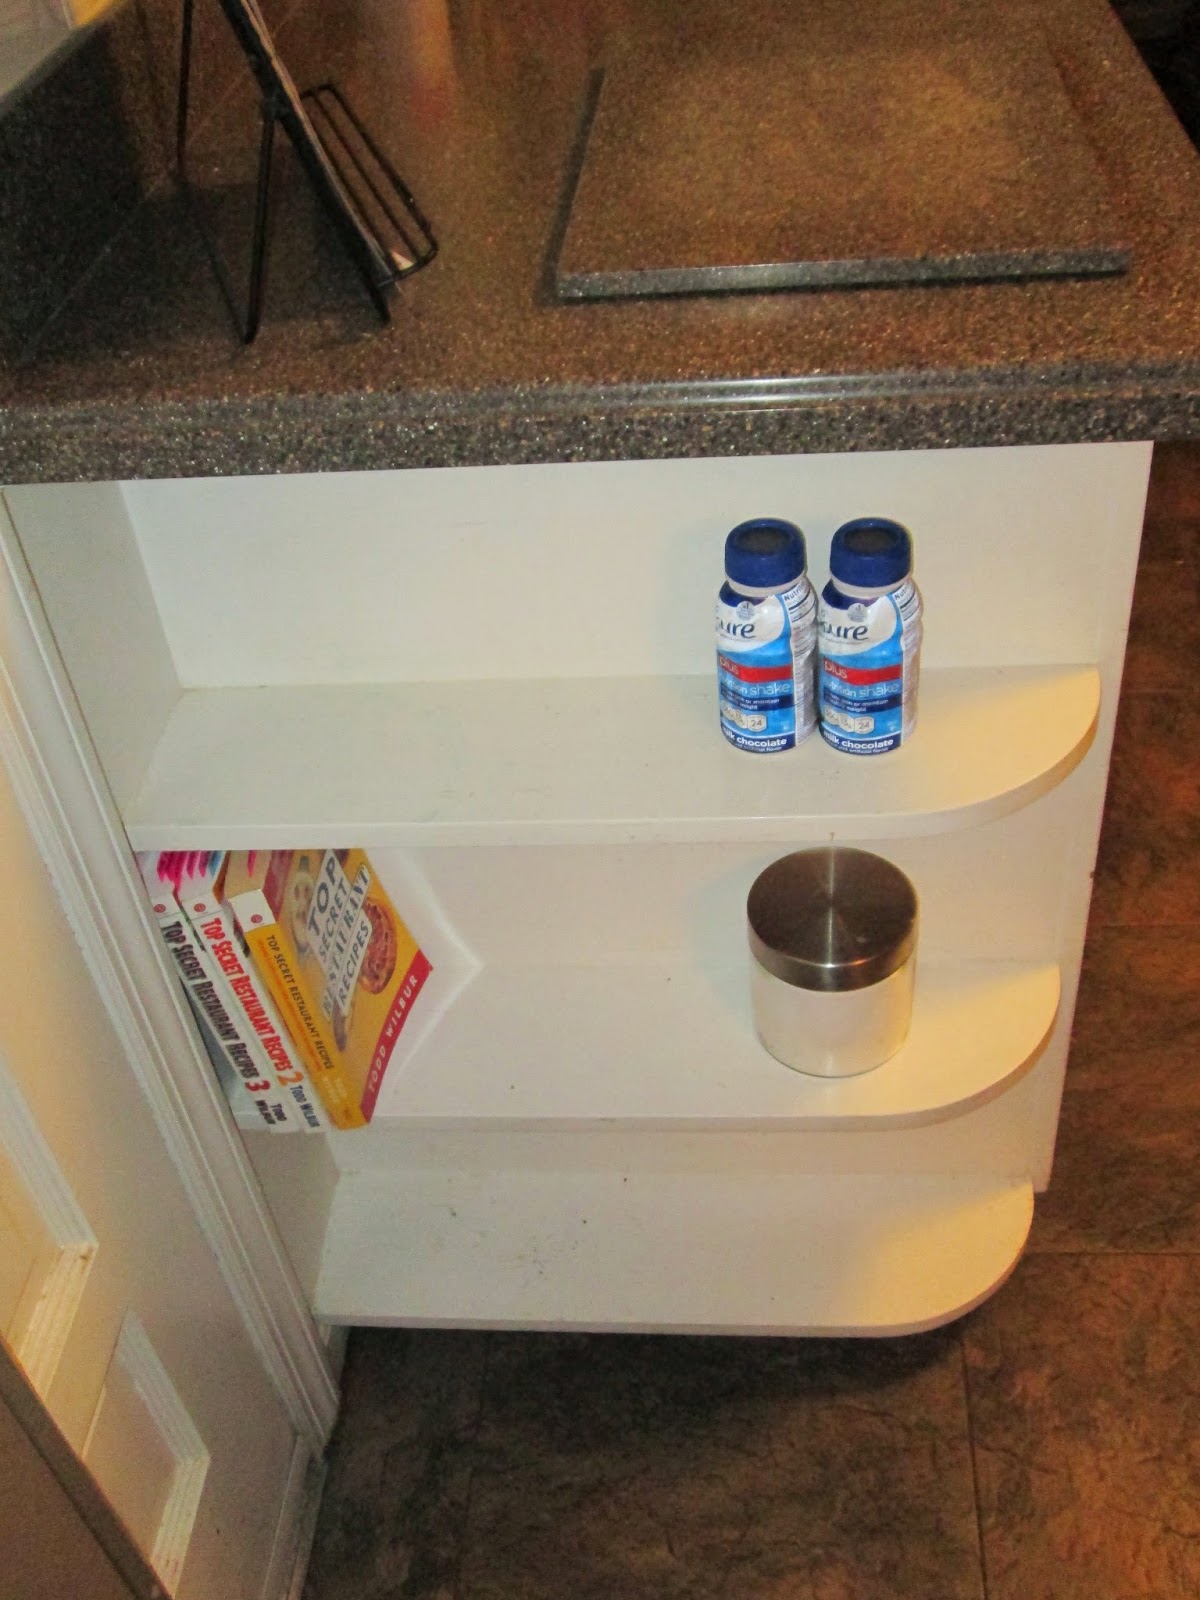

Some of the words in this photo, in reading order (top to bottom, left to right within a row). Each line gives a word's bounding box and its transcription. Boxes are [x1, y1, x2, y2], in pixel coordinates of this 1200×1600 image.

[824, 660, 848, 679] plus
[750, 682, 791, 696] shake
[859, 683, 899, 698] shake
[751, 719, 762, 728] 24
[858, 721, 870, 730] 24
[736, 735, 788, 748] chocolate
[823, 730, 840, 745] milk
[841, 738, 894, 750] chocolate
[308, 856, 337, 936] TOP
[160, 920, 187, 944] TOP
[200, 917, 226, 940] TOP
[318, 877, 348, 963] SECRET
[211, 940, 245, 977] SECRET
[266, 933, 282, 953] TOP
[171, 943, 208, 981] SECRET
[273, 952, 297, 984] SECRET
[338, 921, 370, 1006] RECIPES
[191, 980, 241, 1042] RESTAURANT
[229, 974, 276, 1036] RESTAURANT
[289, 985, 320, 1039] RESTAURANT
[368, 1045, 386, 1093] TODD
[385, 974, 418, 1038] WILBUR
[225, 1042, 261, 1079] RECIPES
[260, 1035, 294, 1072] RECIPES
[314, 1040, 335, 1071] RECIPES
[244, 1080, 272, 1092] 3
[277, 1071, 304, 1087] 2
